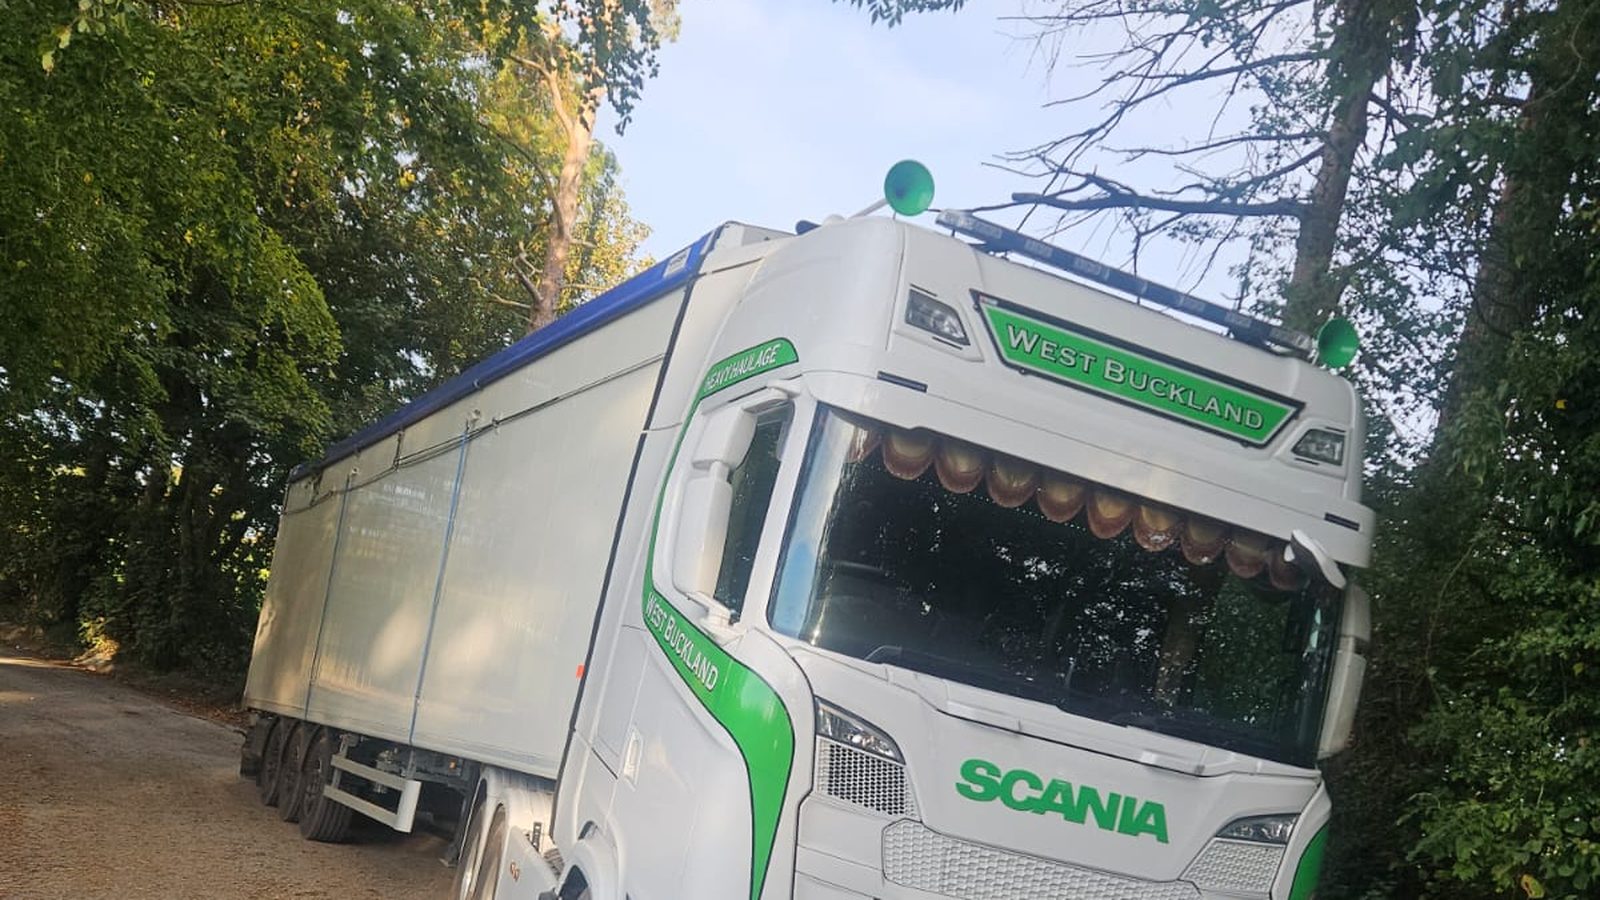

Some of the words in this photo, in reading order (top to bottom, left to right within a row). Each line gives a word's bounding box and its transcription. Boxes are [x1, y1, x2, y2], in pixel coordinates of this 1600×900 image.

[728, 342, 782, 380] HAULAGE
[1006, 323, 1097, 374] WEST
[1103, 357, 1264, 431] BUCKLAND
[645, 591, 668, 632] WEST
[664, 614, 719, 691] BUCKLAND
[955, 758, 1170, 844] SCANIA
